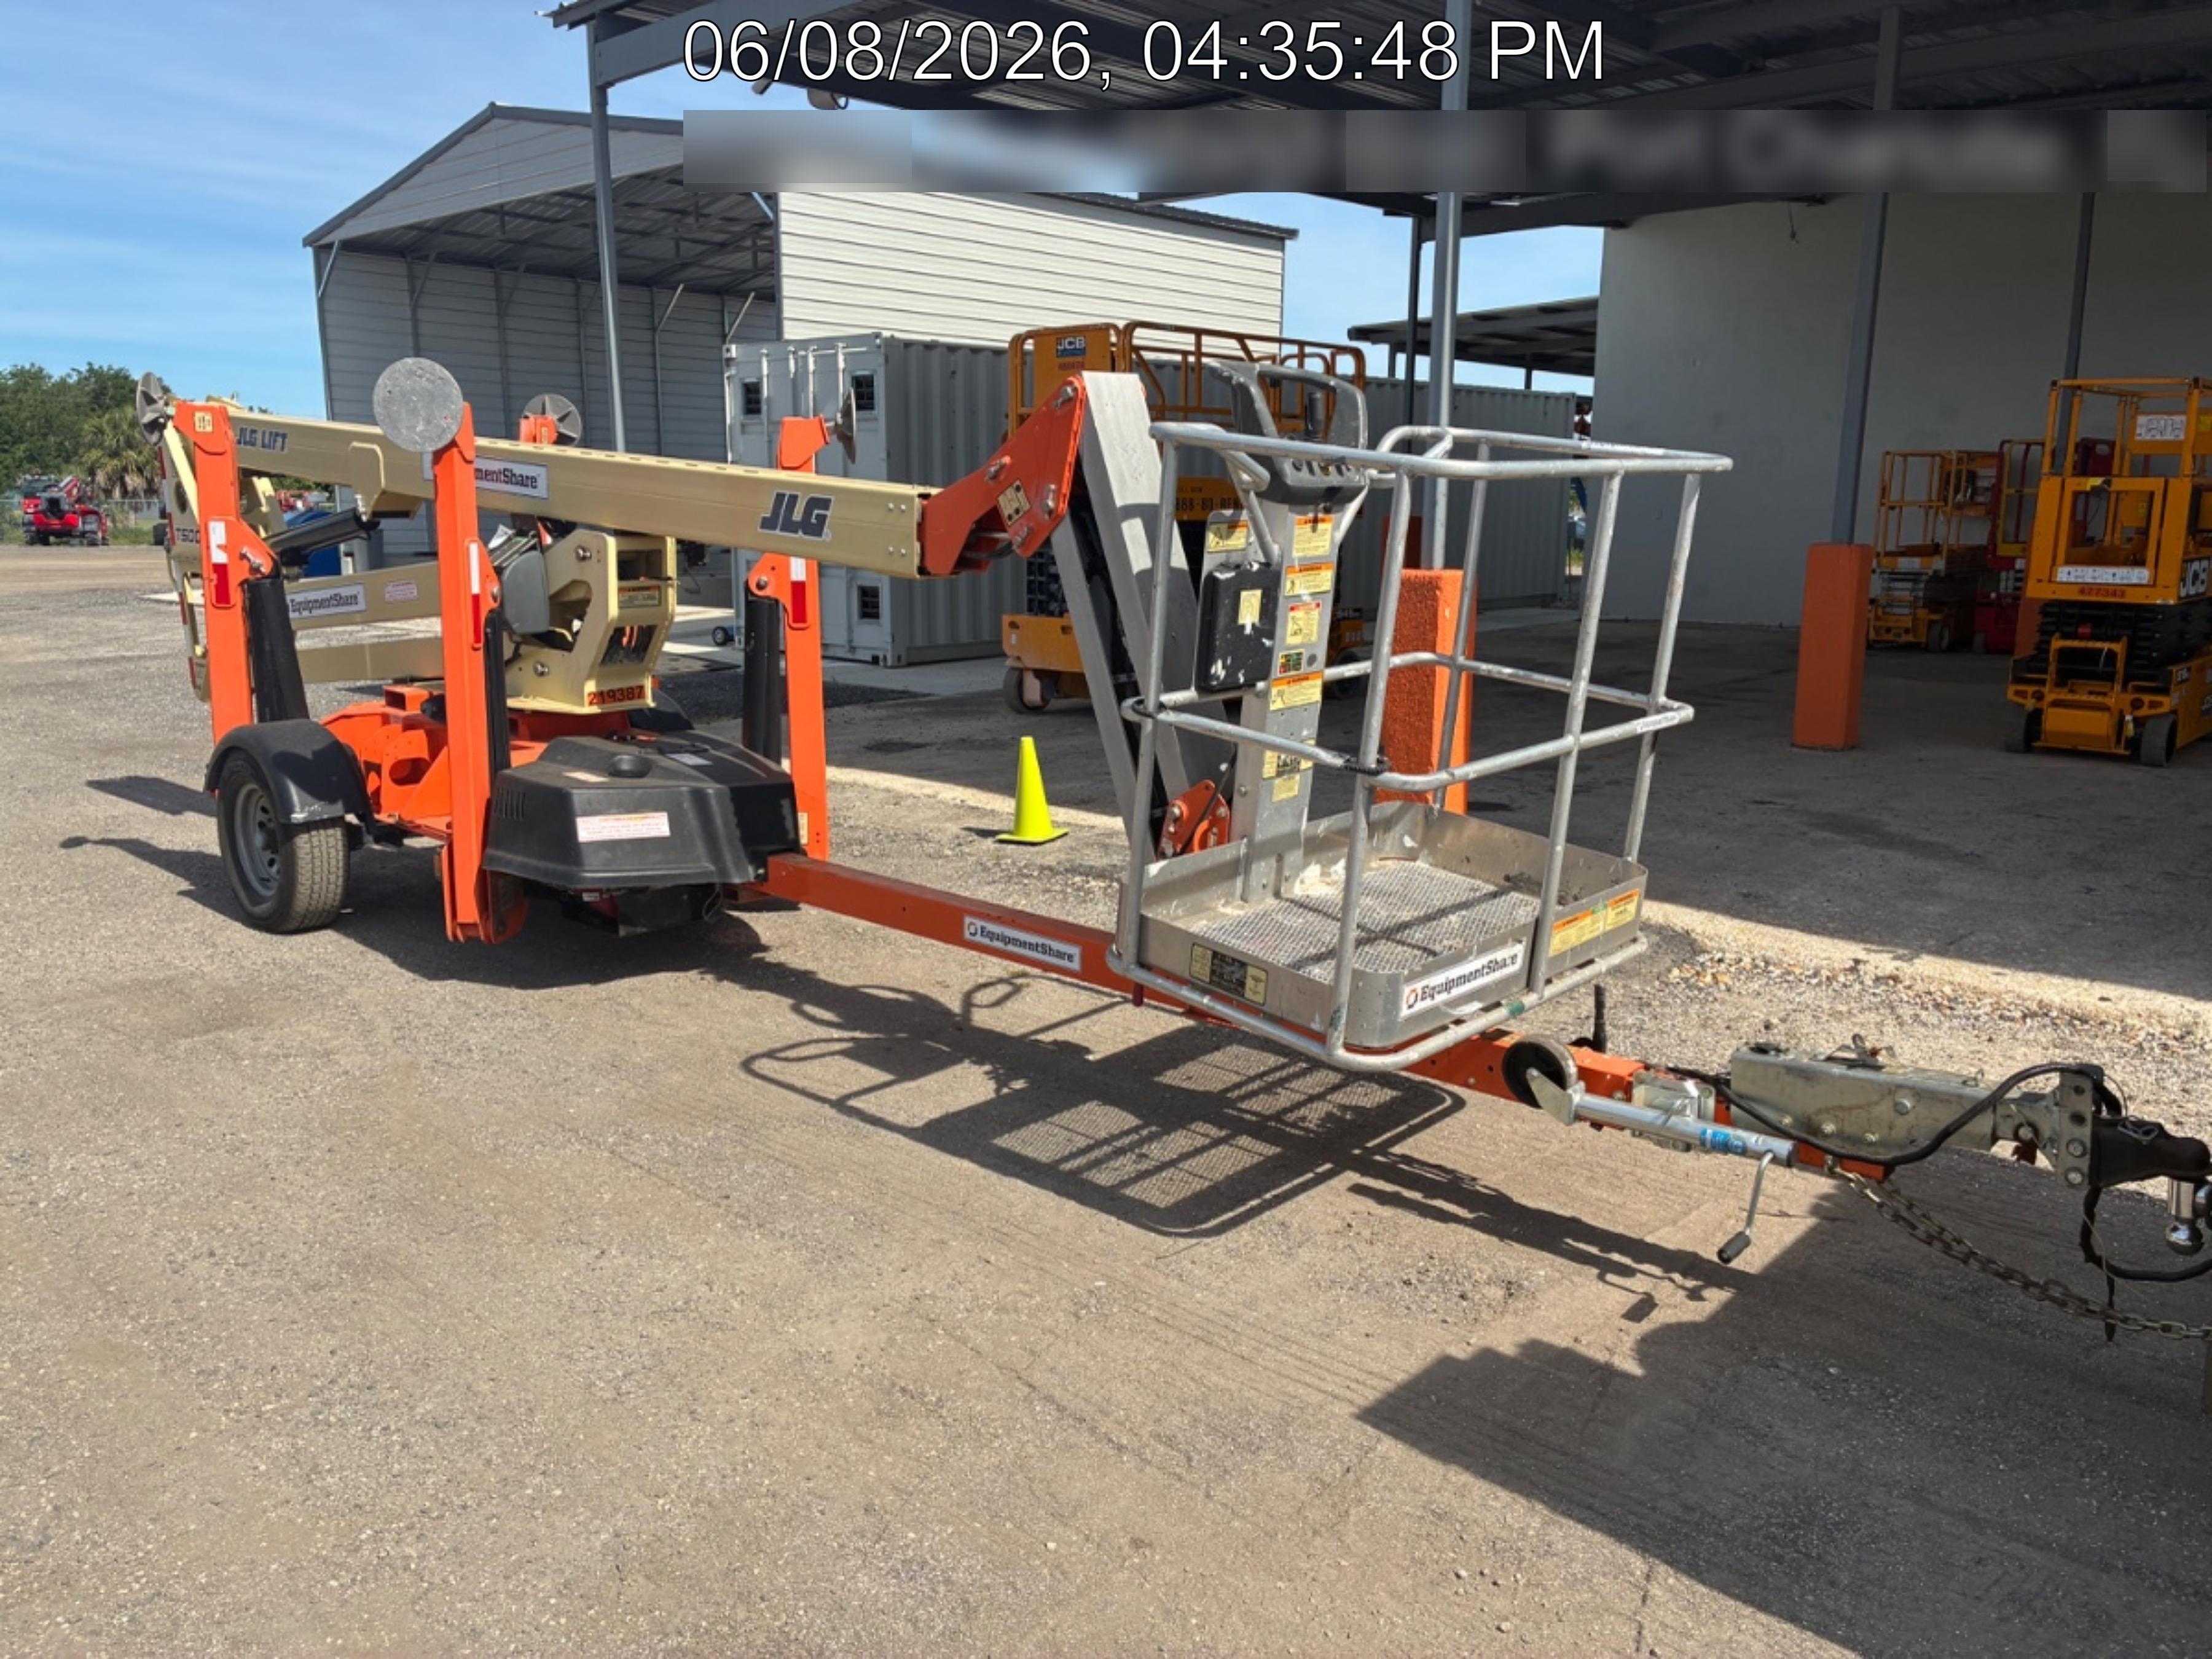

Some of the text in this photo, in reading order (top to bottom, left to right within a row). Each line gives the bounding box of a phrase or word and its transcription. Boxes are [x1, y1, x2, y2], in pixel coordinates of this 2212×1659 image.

[1057, 337, 1085, 350] JCB
[261, 429, 288, 452] LIFT
[475, 466, 539, 489] mentShare
[759, 491, 832, 539] JLG
[2179, 560, 2210, 597] JCB
[290, 593, 360, 615] EquipmentShare
[587, 685, 645, 705] 219387
[980, 924, 1075, 963] EquipmentShare
[1420, 953, 1518, 1002] EquipmentShare
